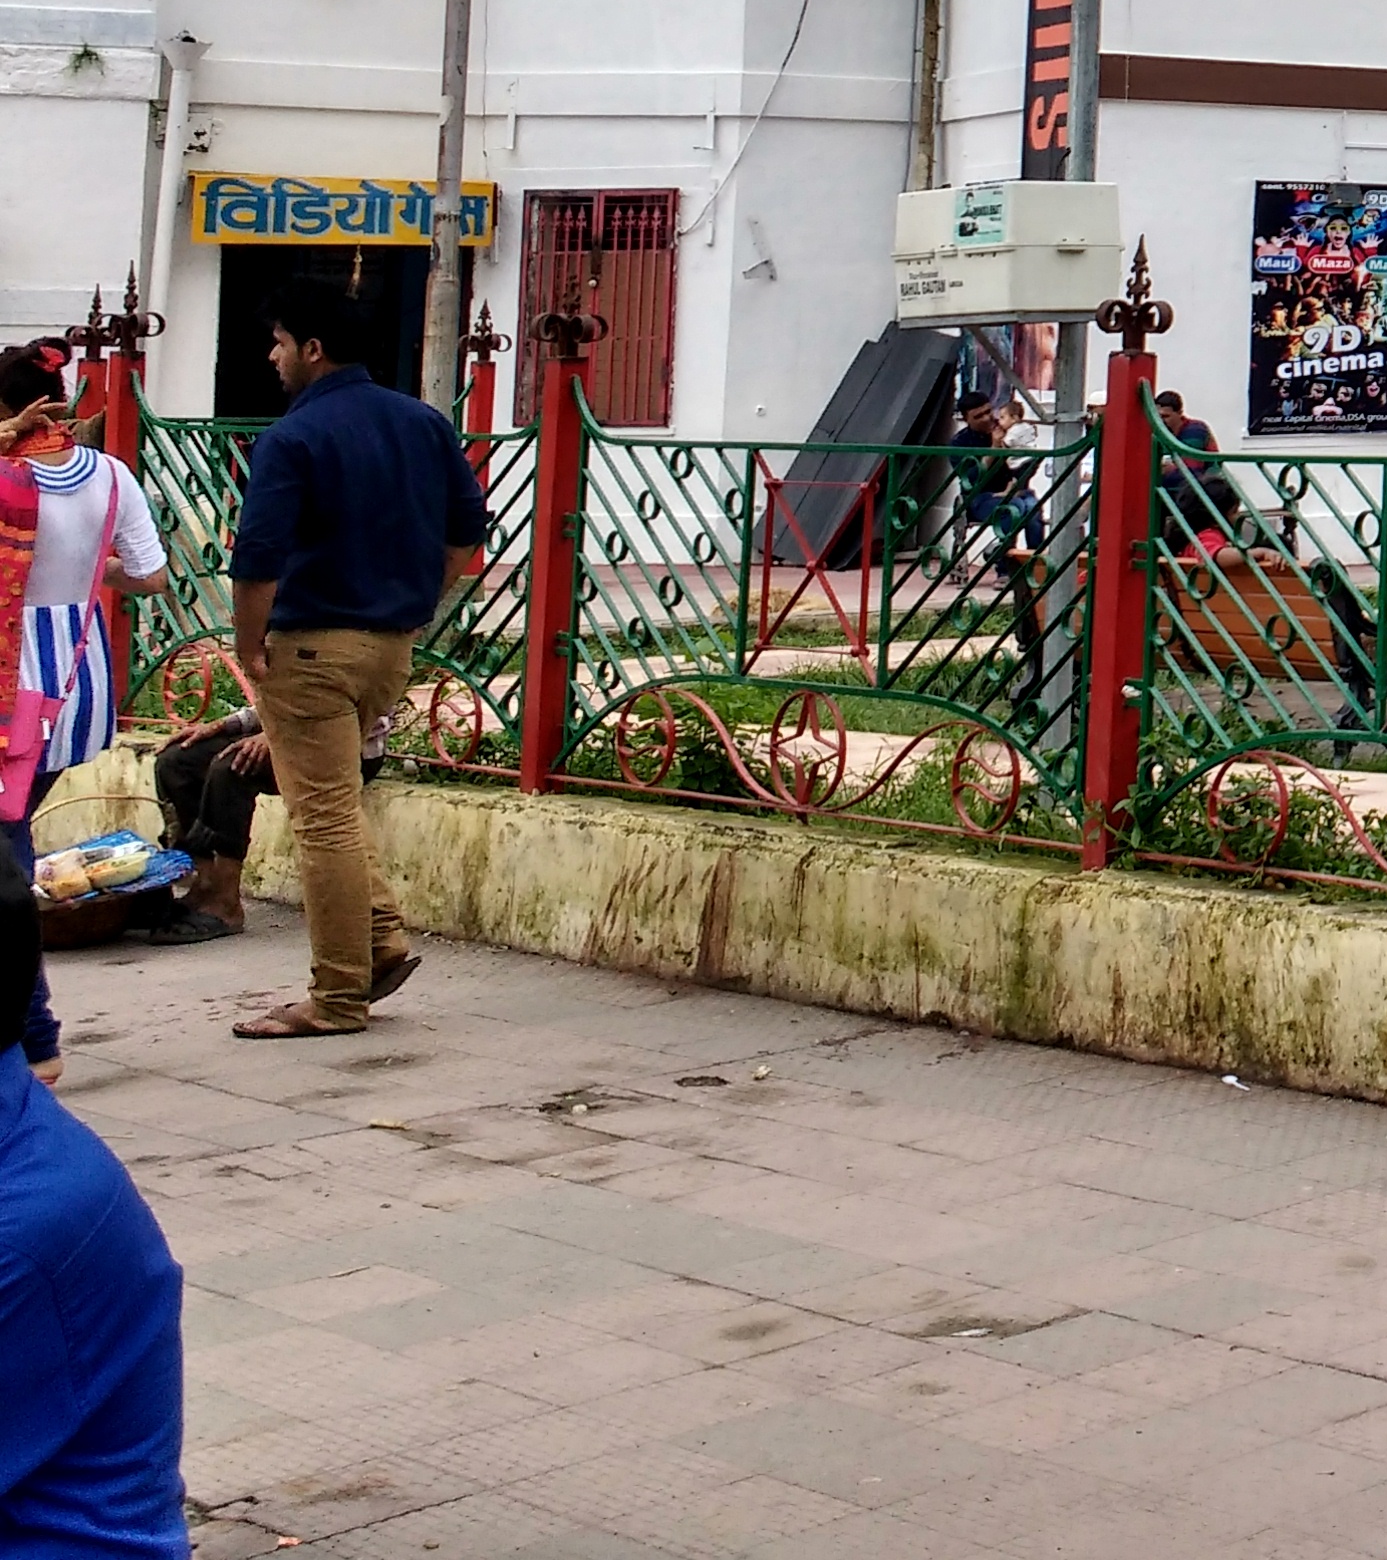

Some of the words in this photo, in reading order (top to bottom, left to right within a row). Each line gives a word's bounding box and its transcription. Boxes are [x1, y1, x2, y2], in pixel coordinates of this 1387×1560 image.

[200, 177, 395, 235] विडियो
[1258, 257, 1296, 271] Mauj
[1312, 258, 1351, 270] Maza
[1303, 324, 1363, 354] 9D
[1276, 351, 1385, 379] cinema
